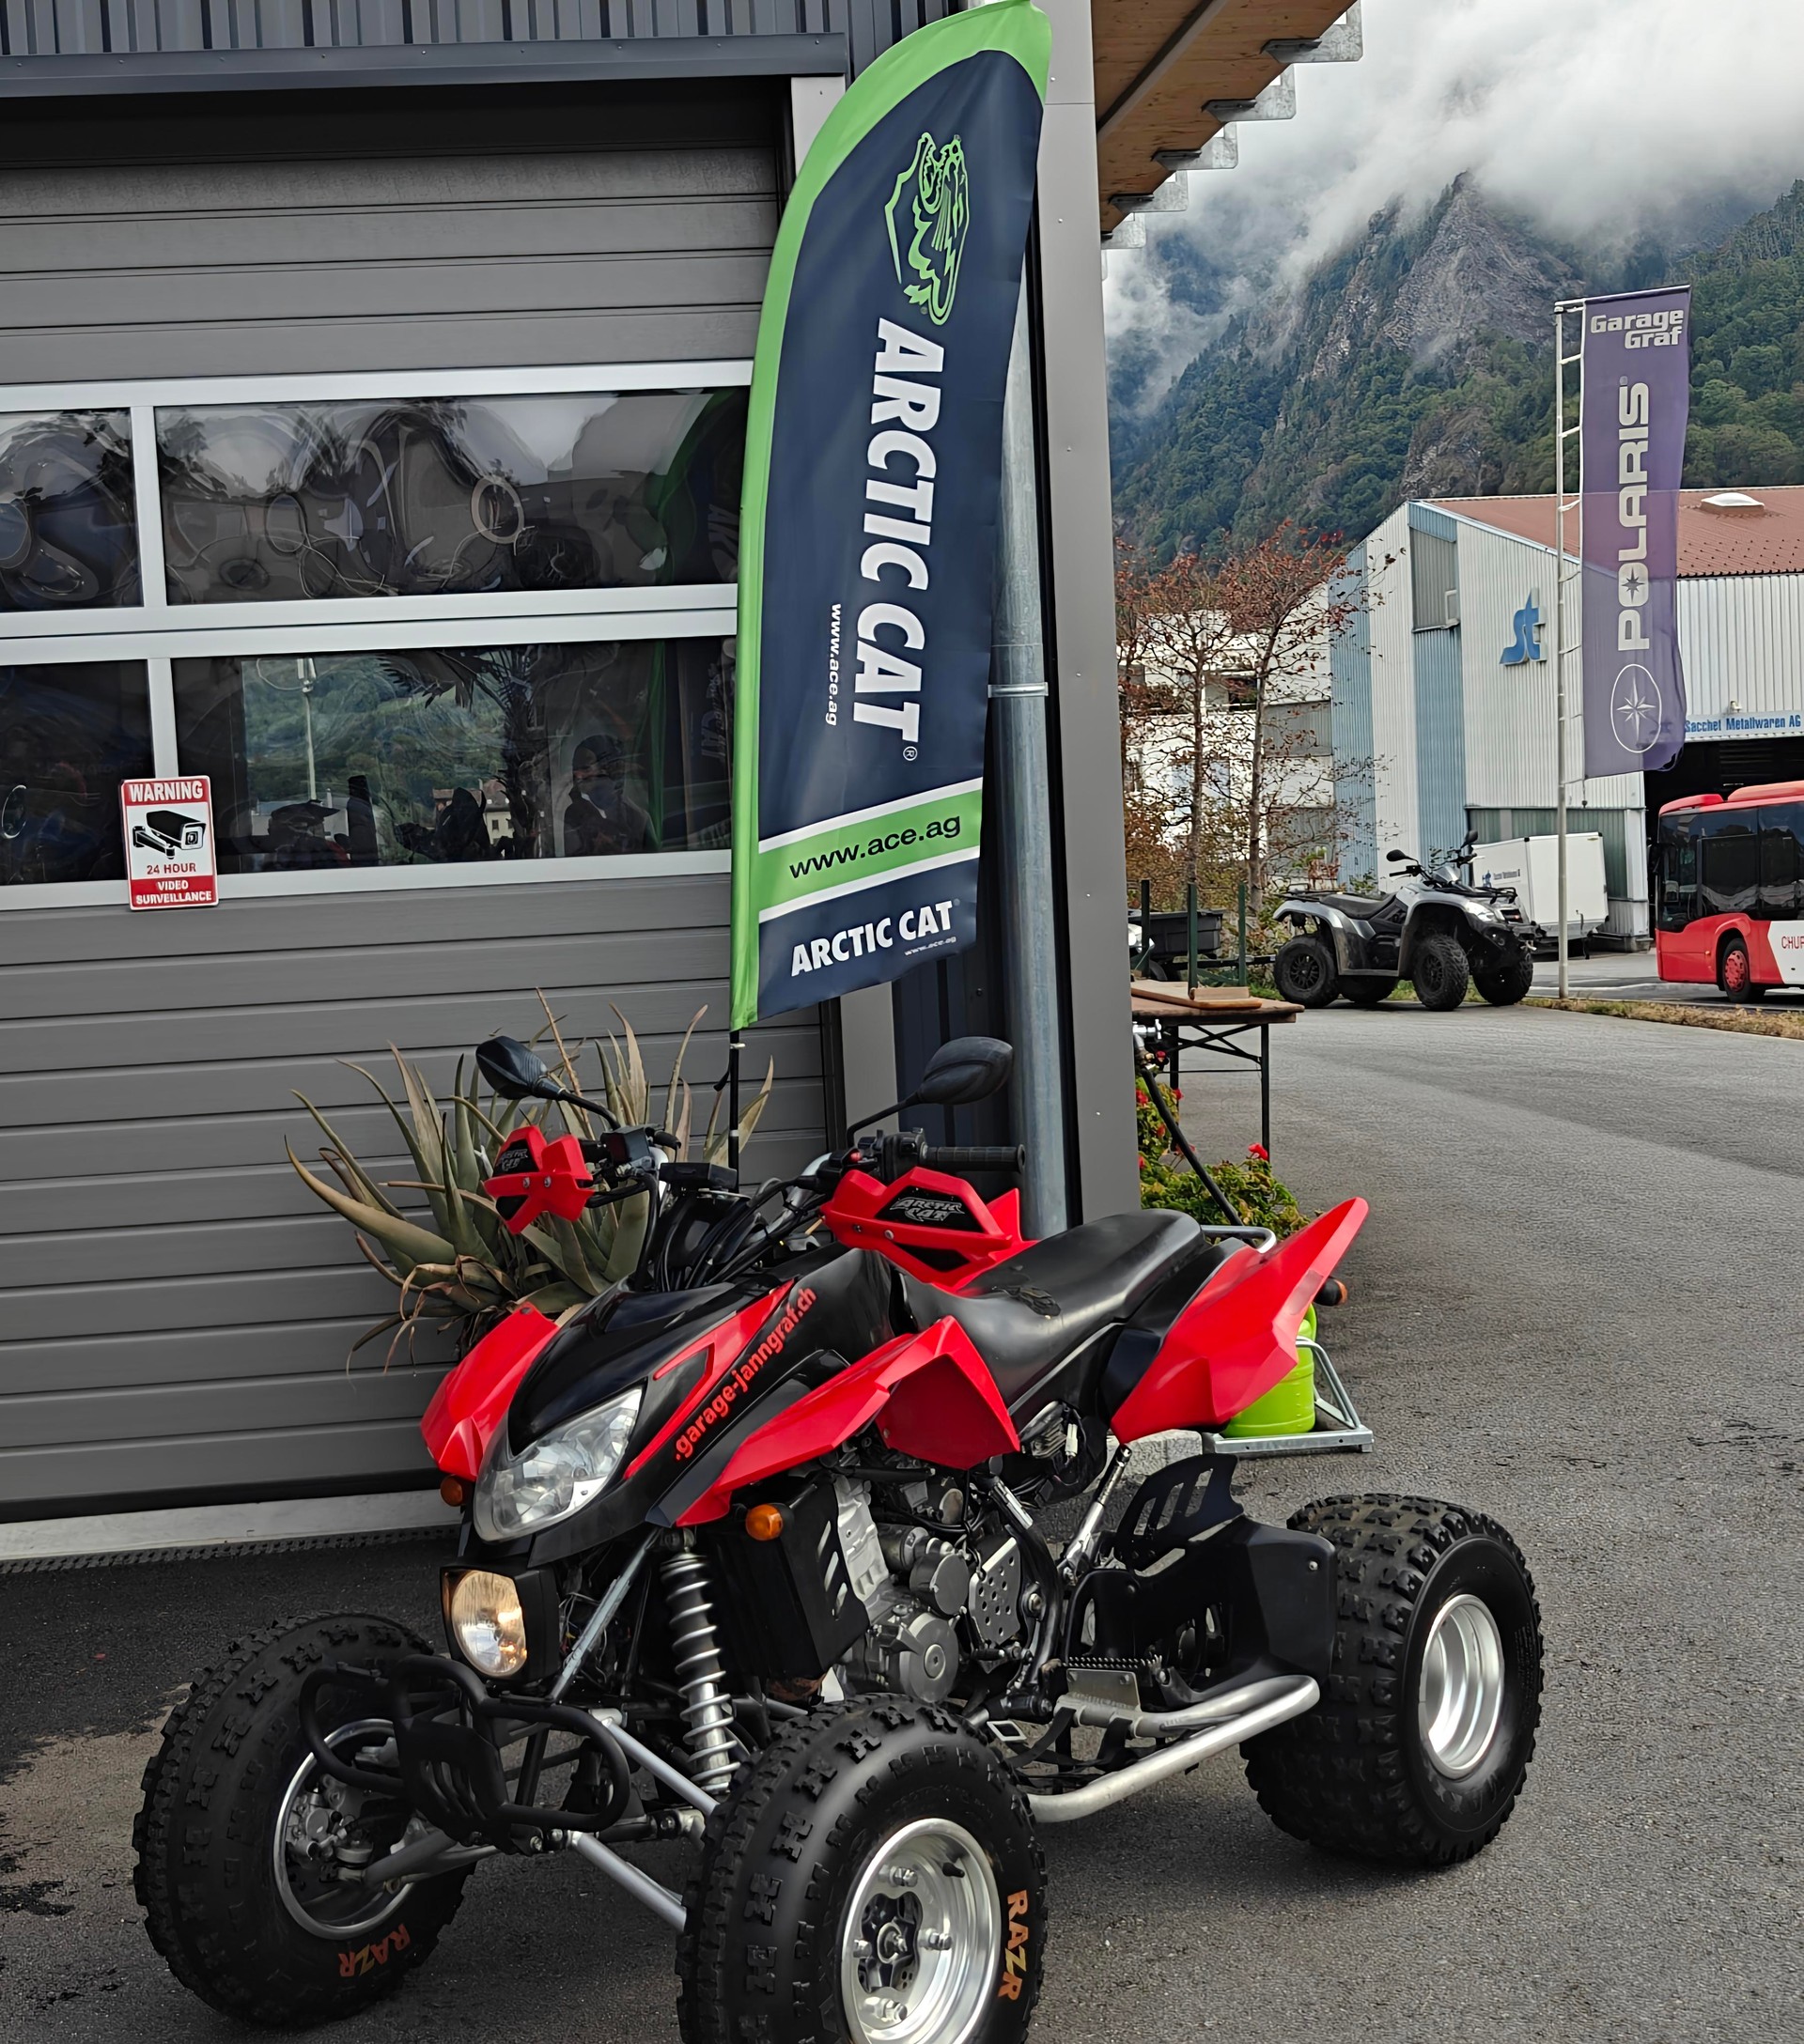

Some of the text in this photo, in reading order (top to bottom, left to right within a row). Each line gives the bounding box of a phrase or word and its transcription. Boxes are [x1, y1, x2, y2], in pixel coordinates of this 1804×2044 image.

[1591, 310, 1685, 333] Garage
[1625, 326, 1683, 348] Graf
[853, 317, 945, 743] ARCTIC CAT
[1618, 382, 1650, 651] POLARIS
[825, 603, 842, 726] www.ace.ag
[1789, 714, 1801, 728] AG
[129, 781, 204, 802] WARNING
[789, 816, 960, 879] www.ace.ag
[147, 862, 196, 875] 24 HOUR
[157, 879, 189, 890] VIDEO
[135, 890, 212, 905] SURVEILLANCE
[791, 900, 953, 977] ARCTIC CAT
[338, 1923, 411, 1977] RAZR
[997, 1889, 1029, 2001] RAZR
